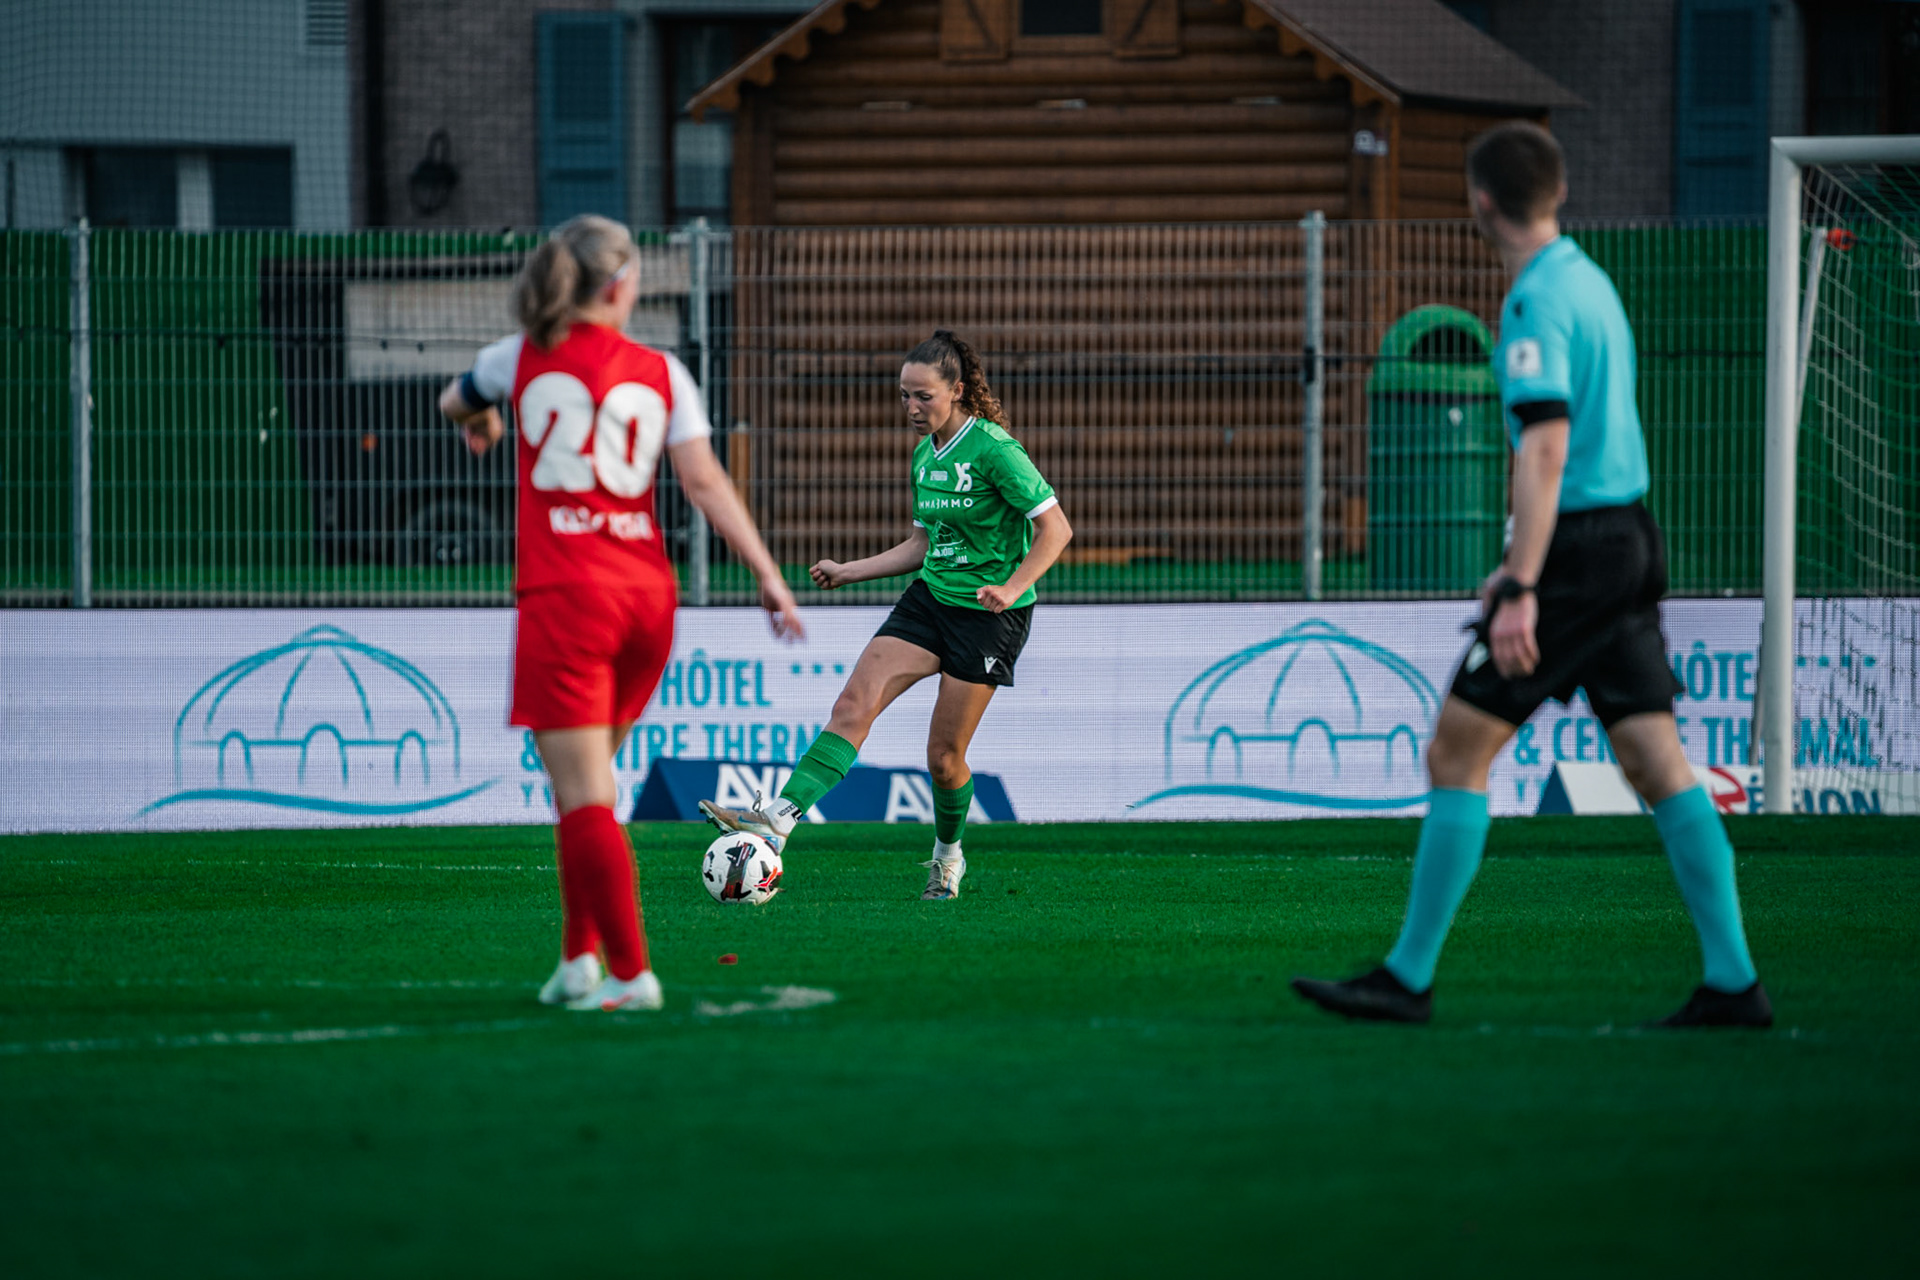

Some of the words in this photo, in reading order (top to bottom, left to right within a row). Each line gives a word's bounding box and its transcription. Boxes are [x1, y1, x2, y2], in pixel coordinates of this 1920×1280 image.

[519, 371, 668, 498] 20
[661, 648, 772, 707] HÔTEL
[1514, 723, 1540, 766] &
